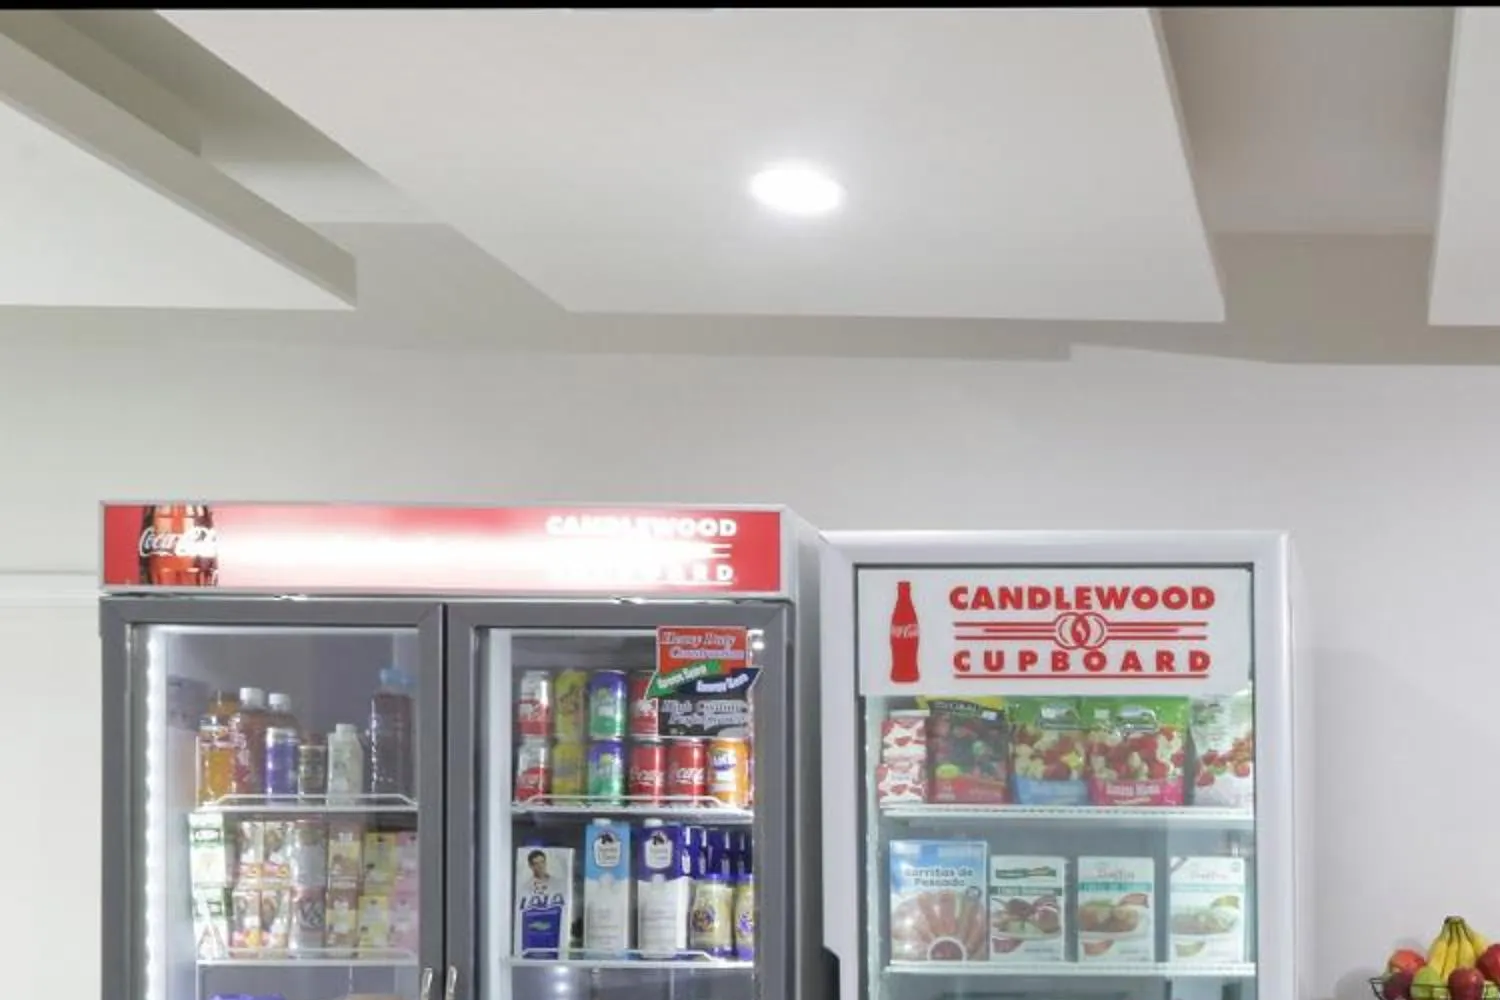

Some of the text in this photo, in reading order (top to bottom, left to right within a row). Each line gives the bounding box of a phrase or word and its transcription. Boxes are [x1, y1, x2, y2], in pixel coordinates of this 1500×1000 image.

[546, 515, 737, 536] CANDLEWOOD
[949, 586, 1215, 611] CANDLEWOOD
[953, 650, 1211, 672] CUPBOARD
